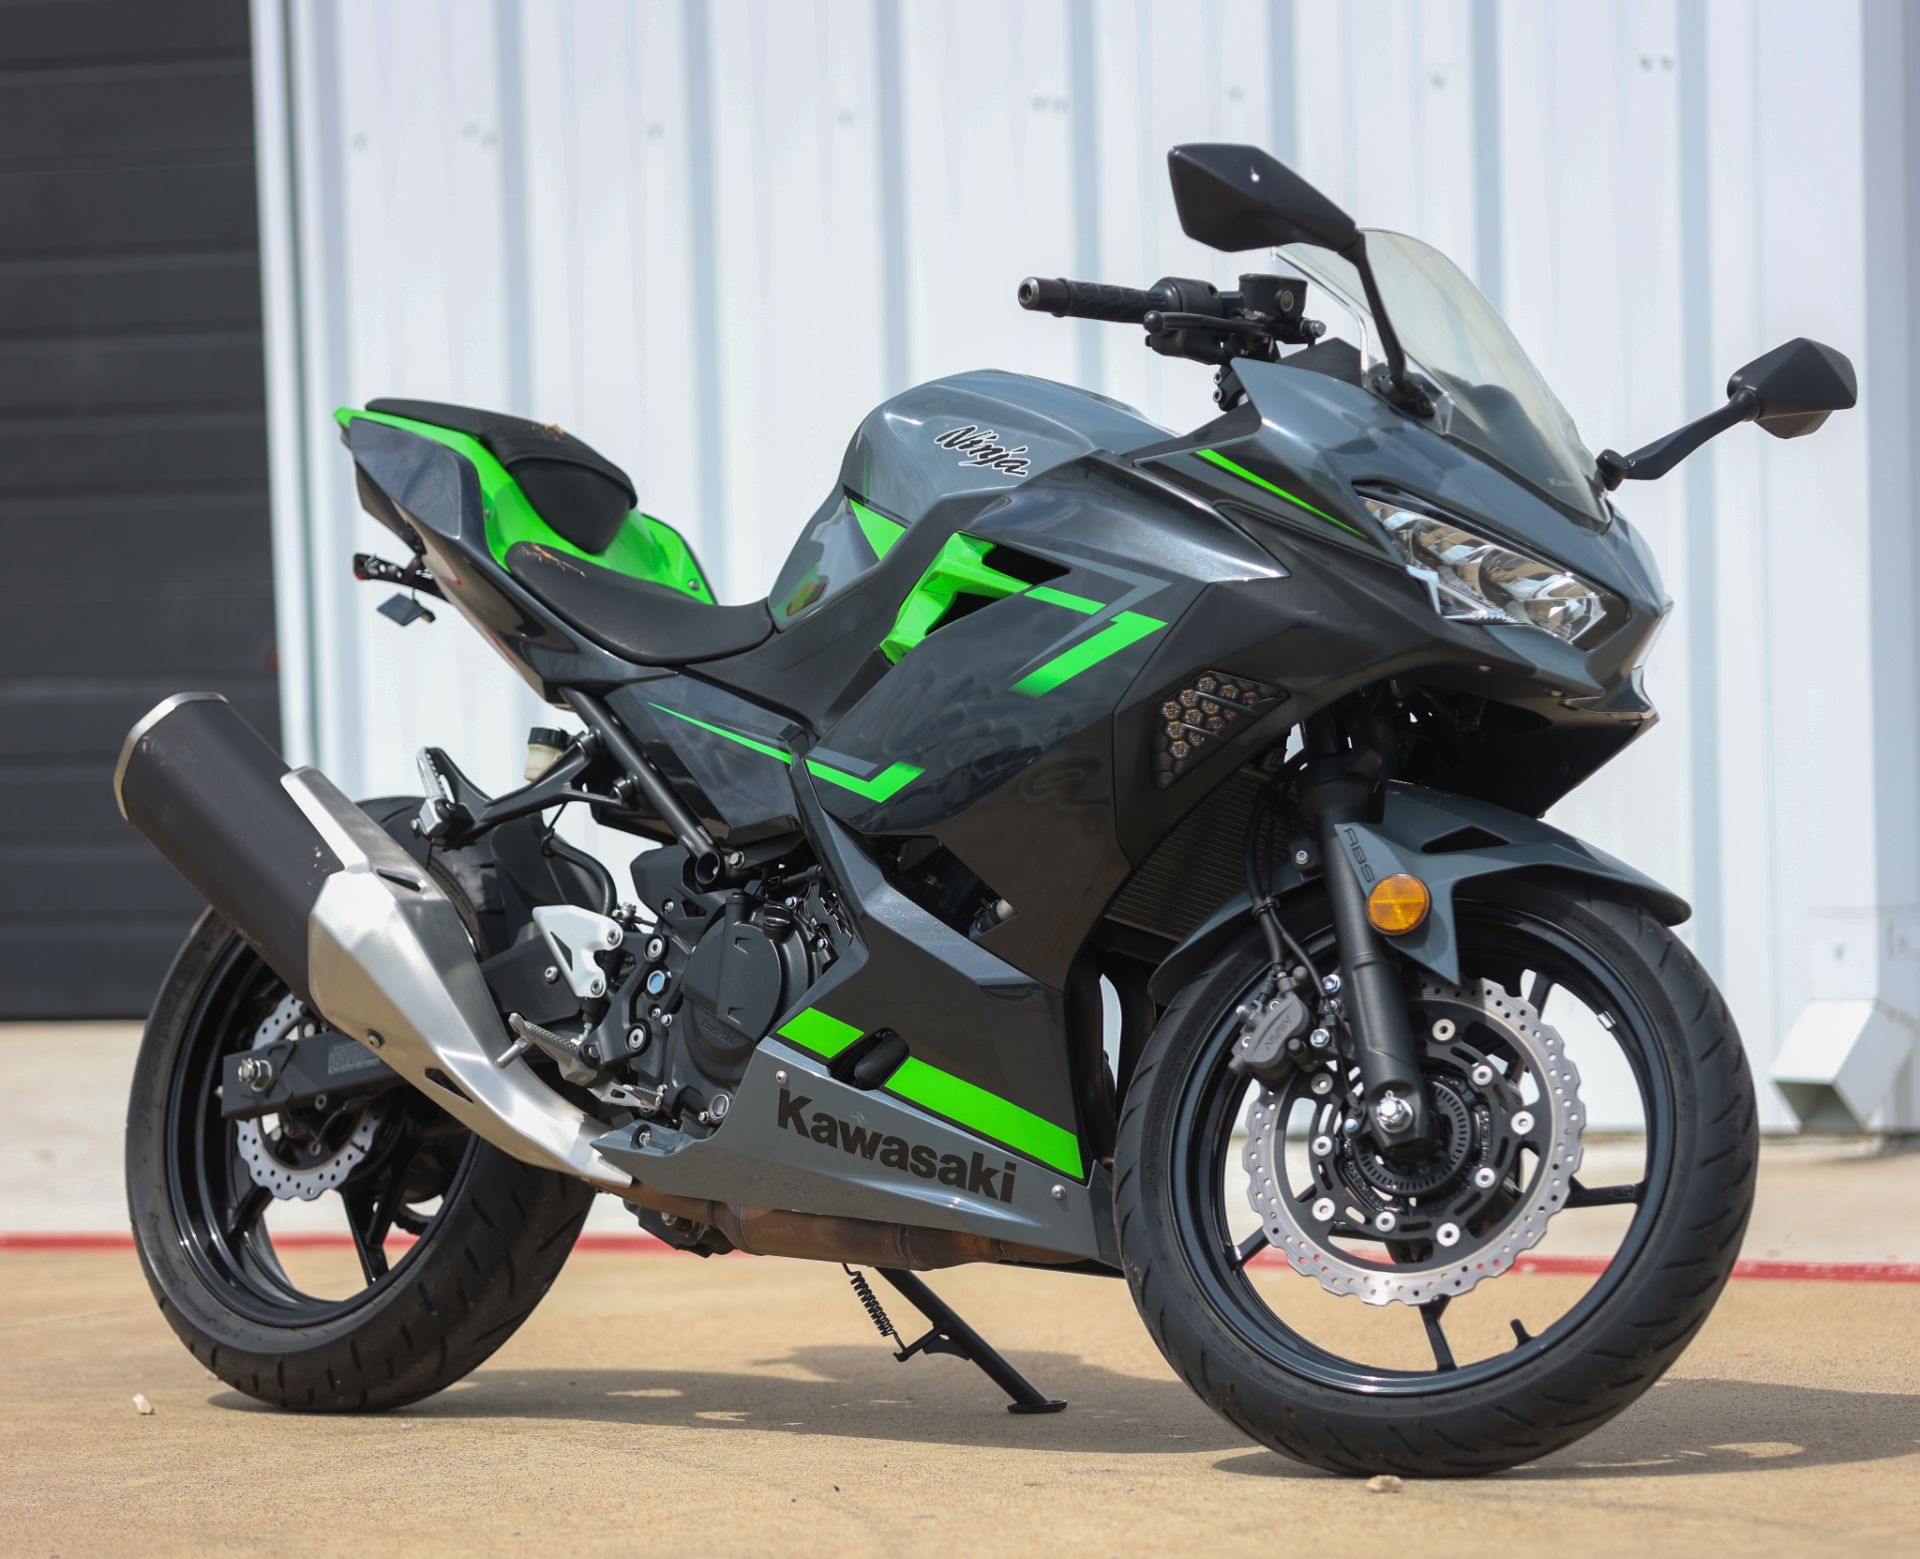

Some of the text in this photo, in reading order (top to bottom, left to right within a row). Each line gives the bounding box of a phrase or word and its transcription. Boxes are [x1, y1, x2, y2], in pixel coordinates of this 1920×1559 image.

[934, 425, 1031, 477] Ninja
[1344, 827, 1375, 883] ABS
[777, 1088, 1017, 1204] Kawasaki
